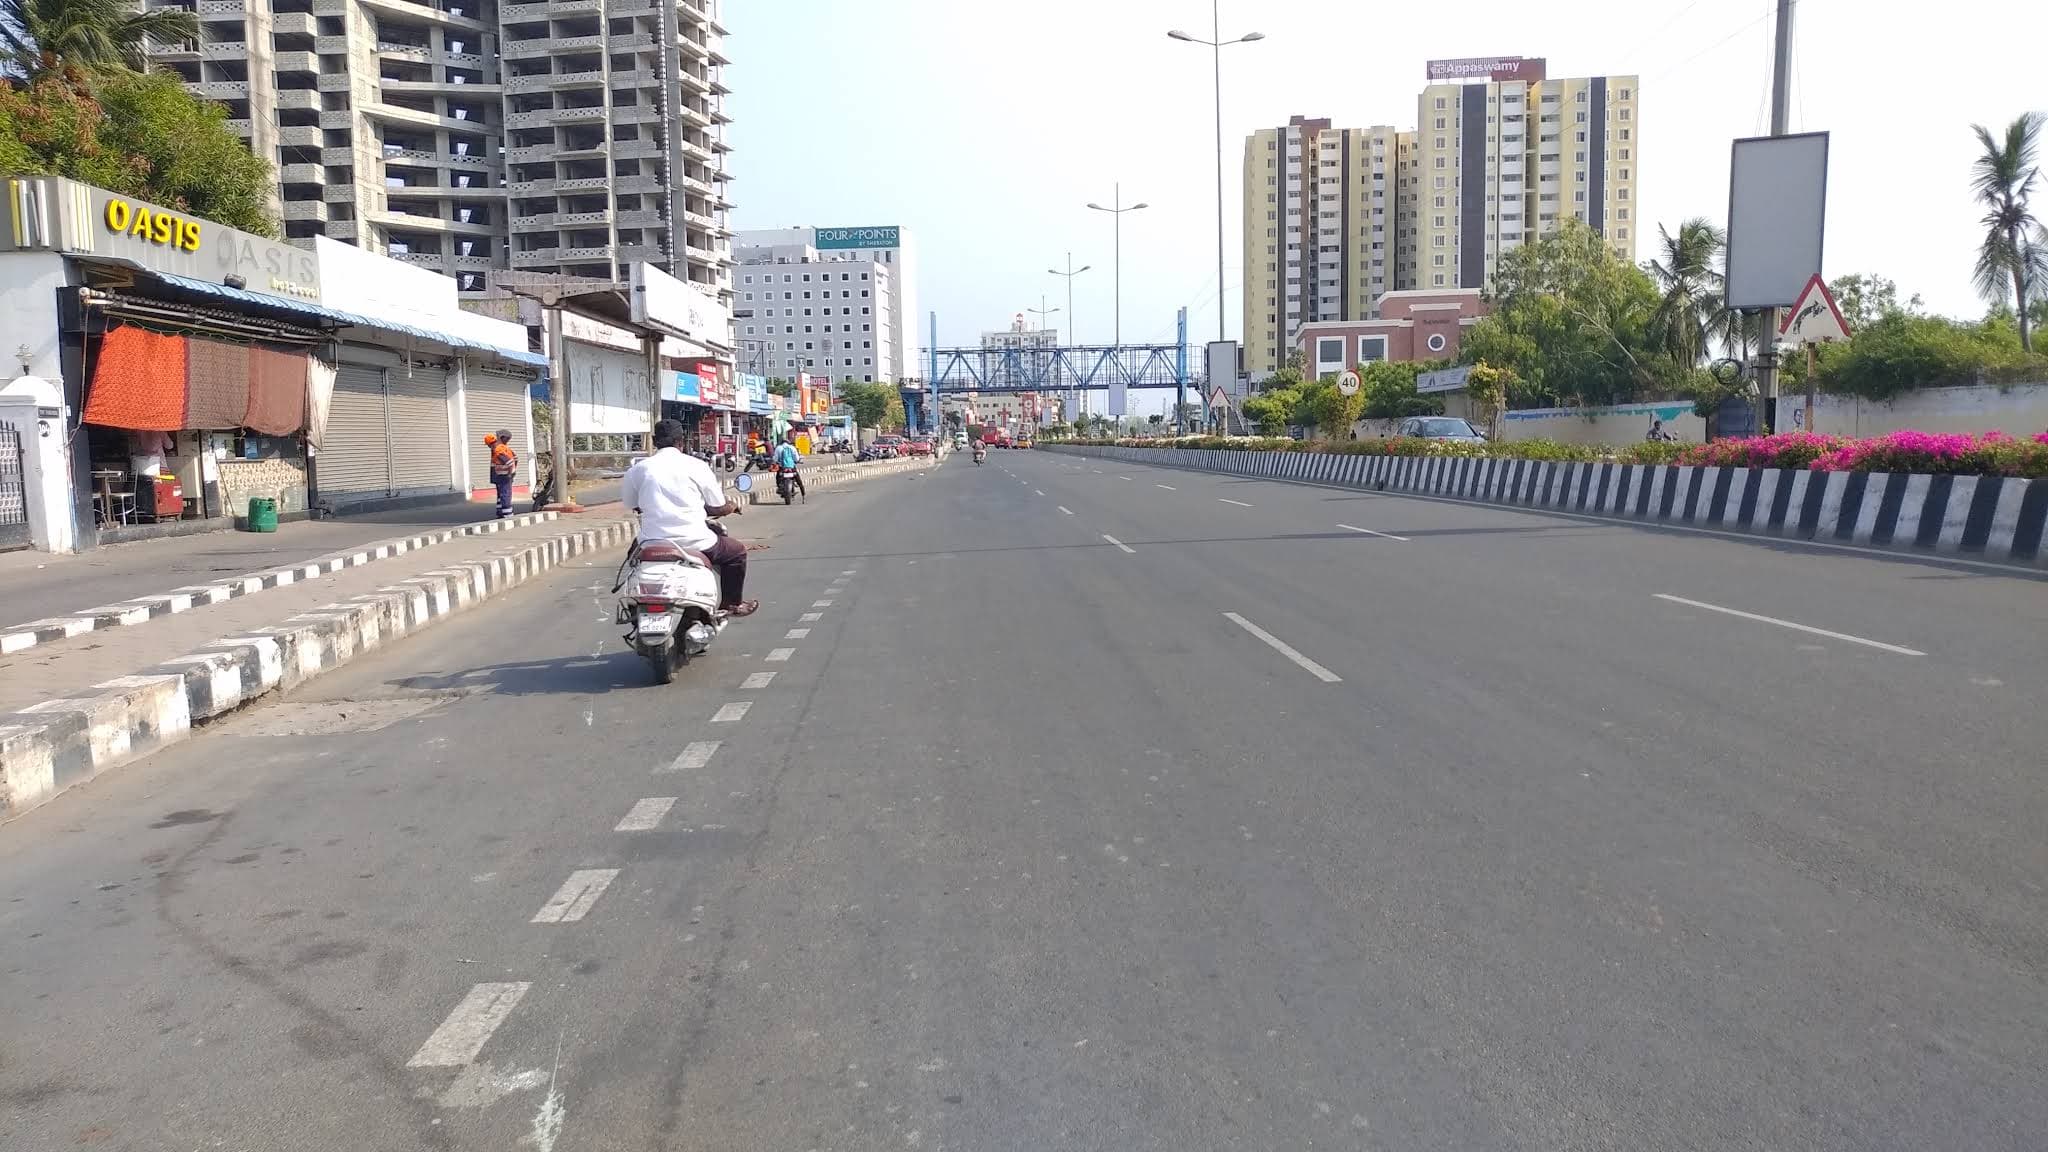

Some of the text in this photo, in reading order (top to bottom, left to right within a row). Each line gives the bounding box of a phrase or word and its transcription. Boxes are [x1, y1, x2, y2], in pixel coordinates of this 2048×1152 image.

[1447, 61, 1520, 75] Appaswamy
[105, 198, 201, 252] OASIS
[818, 228, 897, 241] FOUR POINTS
[217, 230, 315, 284] OASIS
[1342, 376, 1356, 388] 40
